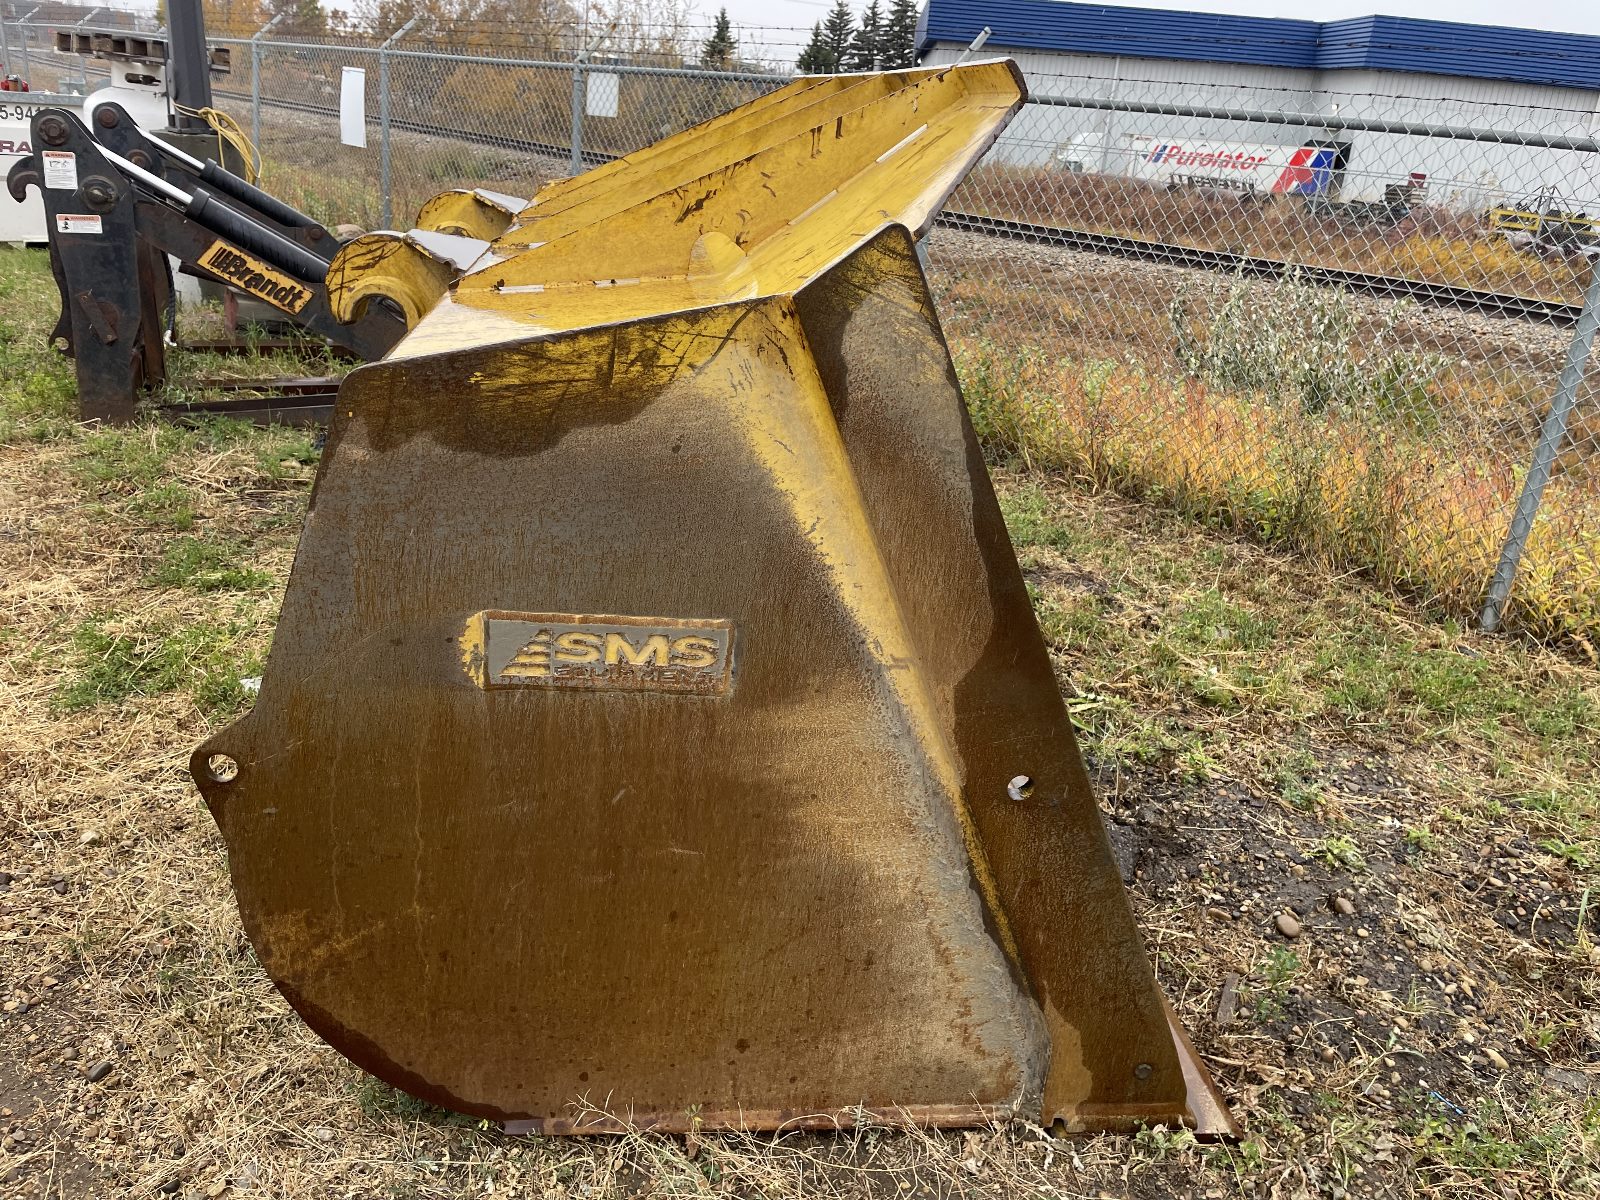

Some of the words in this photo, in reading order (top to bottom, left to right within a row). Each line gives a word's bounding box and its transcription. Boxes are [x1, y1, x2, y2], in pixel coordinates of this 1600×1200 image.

[0, 104, 49, 120] 5-94
[1162, 145, 1268, 170] Purolator
[216, 249, 304, 308] Brandt
[554, 631, 719, 667] SMS
